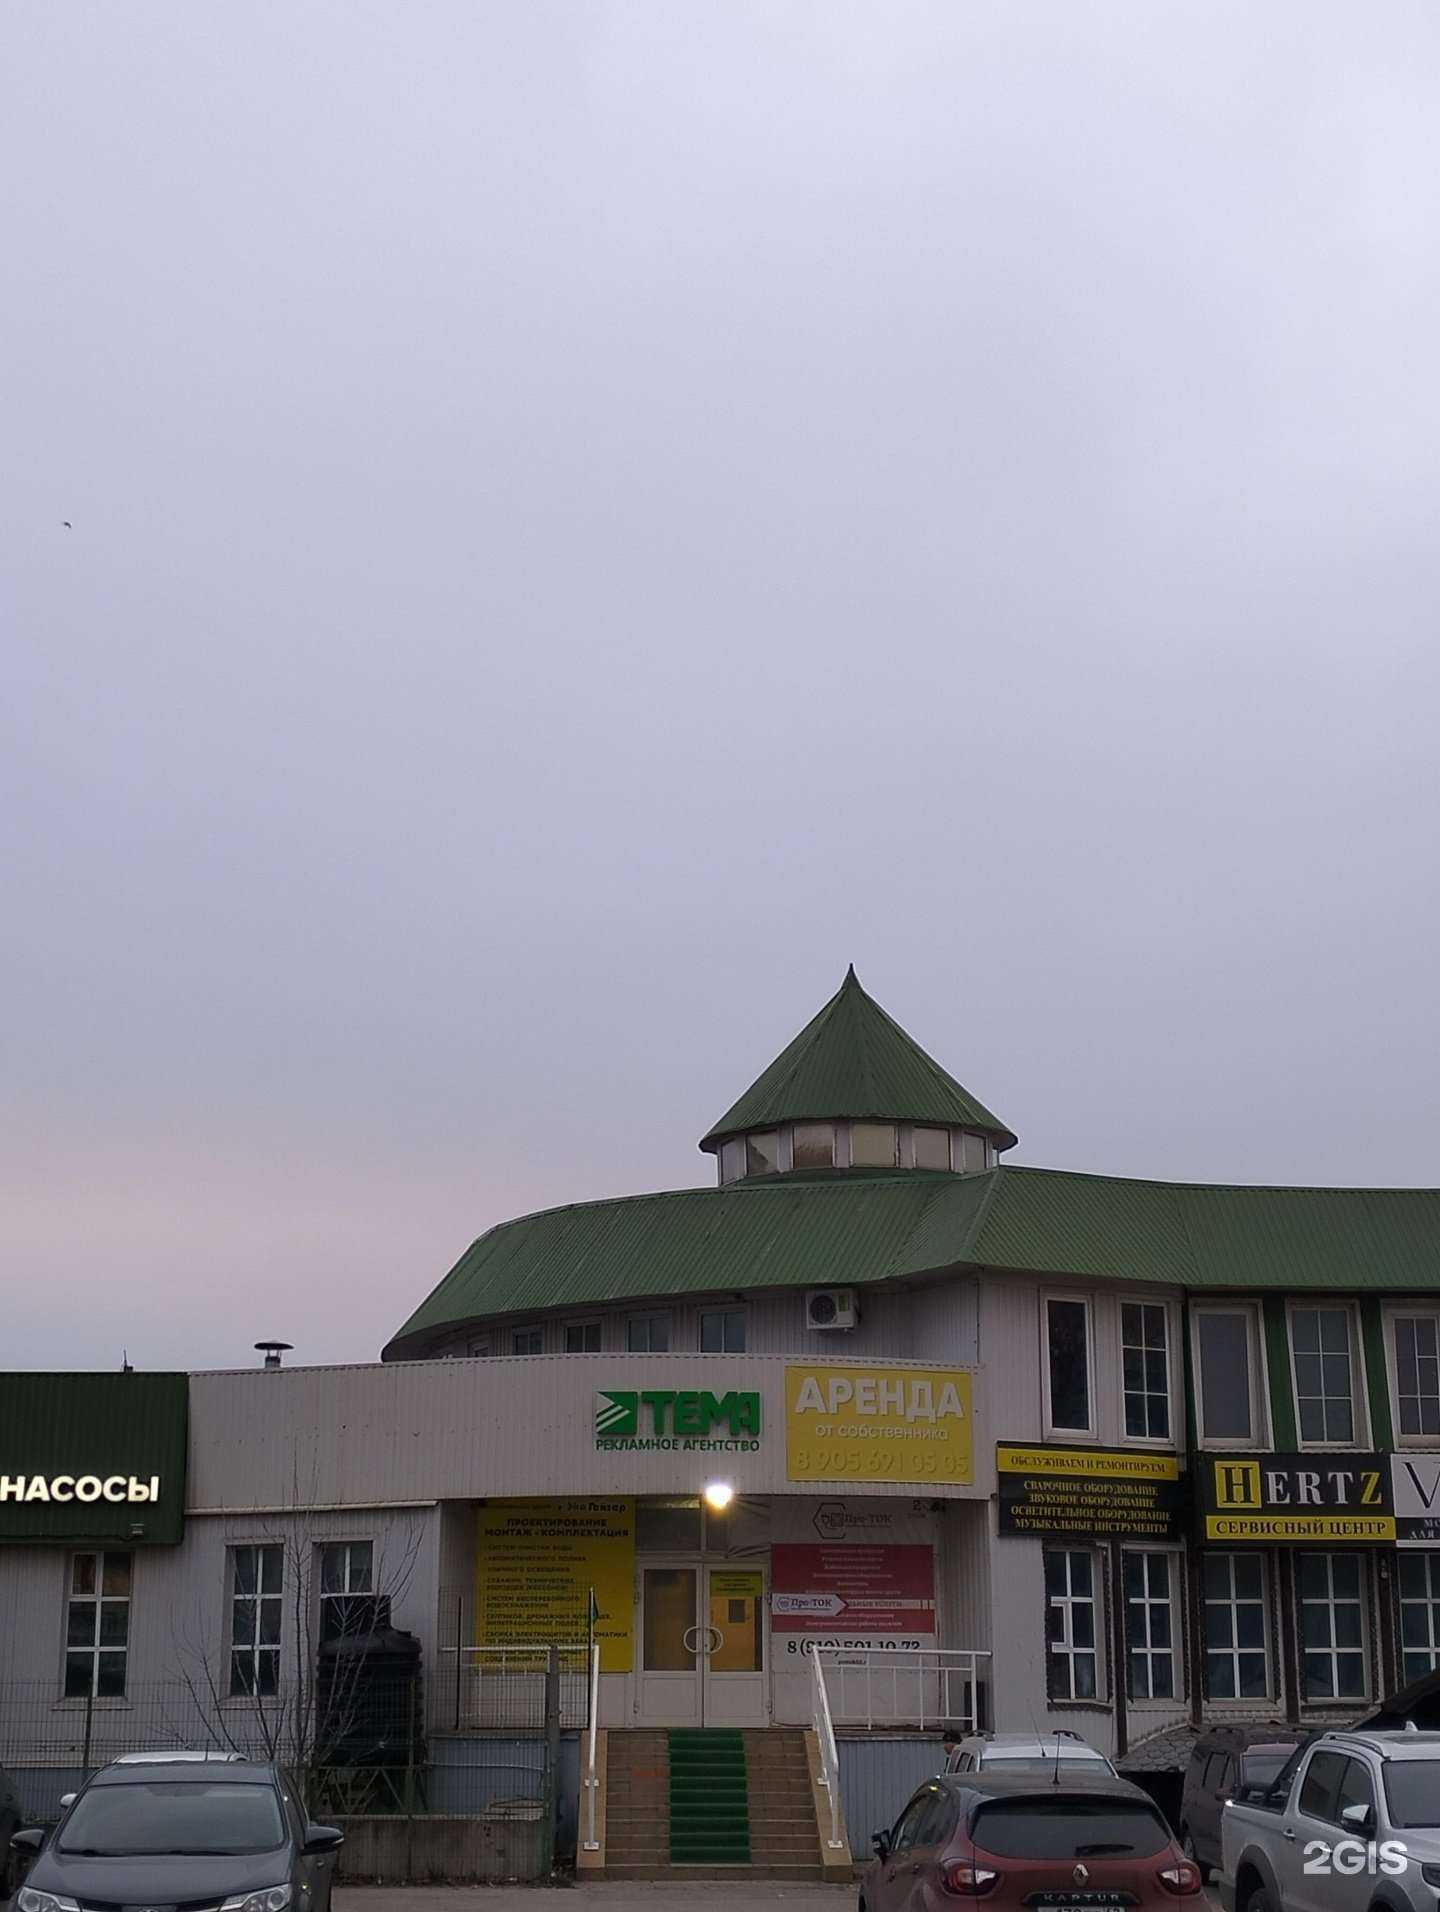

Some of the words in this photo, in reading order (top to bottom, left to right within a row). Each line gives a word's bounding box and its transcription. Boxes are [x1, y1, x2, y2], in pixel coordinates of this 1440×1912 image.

[795, 1376, 965, 1424] АРЕНДА
[641, 1391, 760, 1436] ТЕМА
[816, 1425, 832, 1437] от
[838, 1424, 948, 1440] собственника
[596, 1439, 679, 1450] РЕКЛАМНОЕ
[683, 1440, 760, 1451] АГЕНТСТВО
[797, 1449, 811, 1471] 8
[815, 1449, 862, 1472] 905
[866, 1449, 905, 1473] 691
[1011, 1456, 1086, 1470] ОБСЛУЖИВАЕМ
[1087, 1460, 1093, 1470] И
[1095, 1460, 1166, 1473] РЕМОНТИРУЕМ
[0, 1475, 160, 1501] НАСОСЫ
[1024, 1480, 1083, 1493] СВАРОЧНОЕ
[1220, 1466, 1383, 1505] HERTZ
[1030, 1493, 1079, 1505] ЗВУКОВОЕ
[1081, 1495, 1155, 1508] ОБОРУДОВАНИЕ
[1011, 1505, 1096, 1518] ОСВЕТИТЕЛЬНОЕ
[1097, 1508, 1172, 1521] ОБОРУДОВАНИЕ
[507, 1518, 608, 1527] ПРОЕКТИРОВАНИЕ
[1015, 1518, 1093, 1531] МУЗЫКАЛЬНЫЕ
[1094, 1521, 1168, 1533] ИНСТРУМЕНТЫ
[1216, 1519, 1324, 1536] СЕРВИСНЫЙ
[1329, 1521, 1386, 1537] ЦЕНТР
[484, 1528, 532, 1537] МОНТАЖ
[541, 1528, 630, 1538] КОМПЛЕКТАЦИЯ
[787, 1640, 798, 1654] 8
